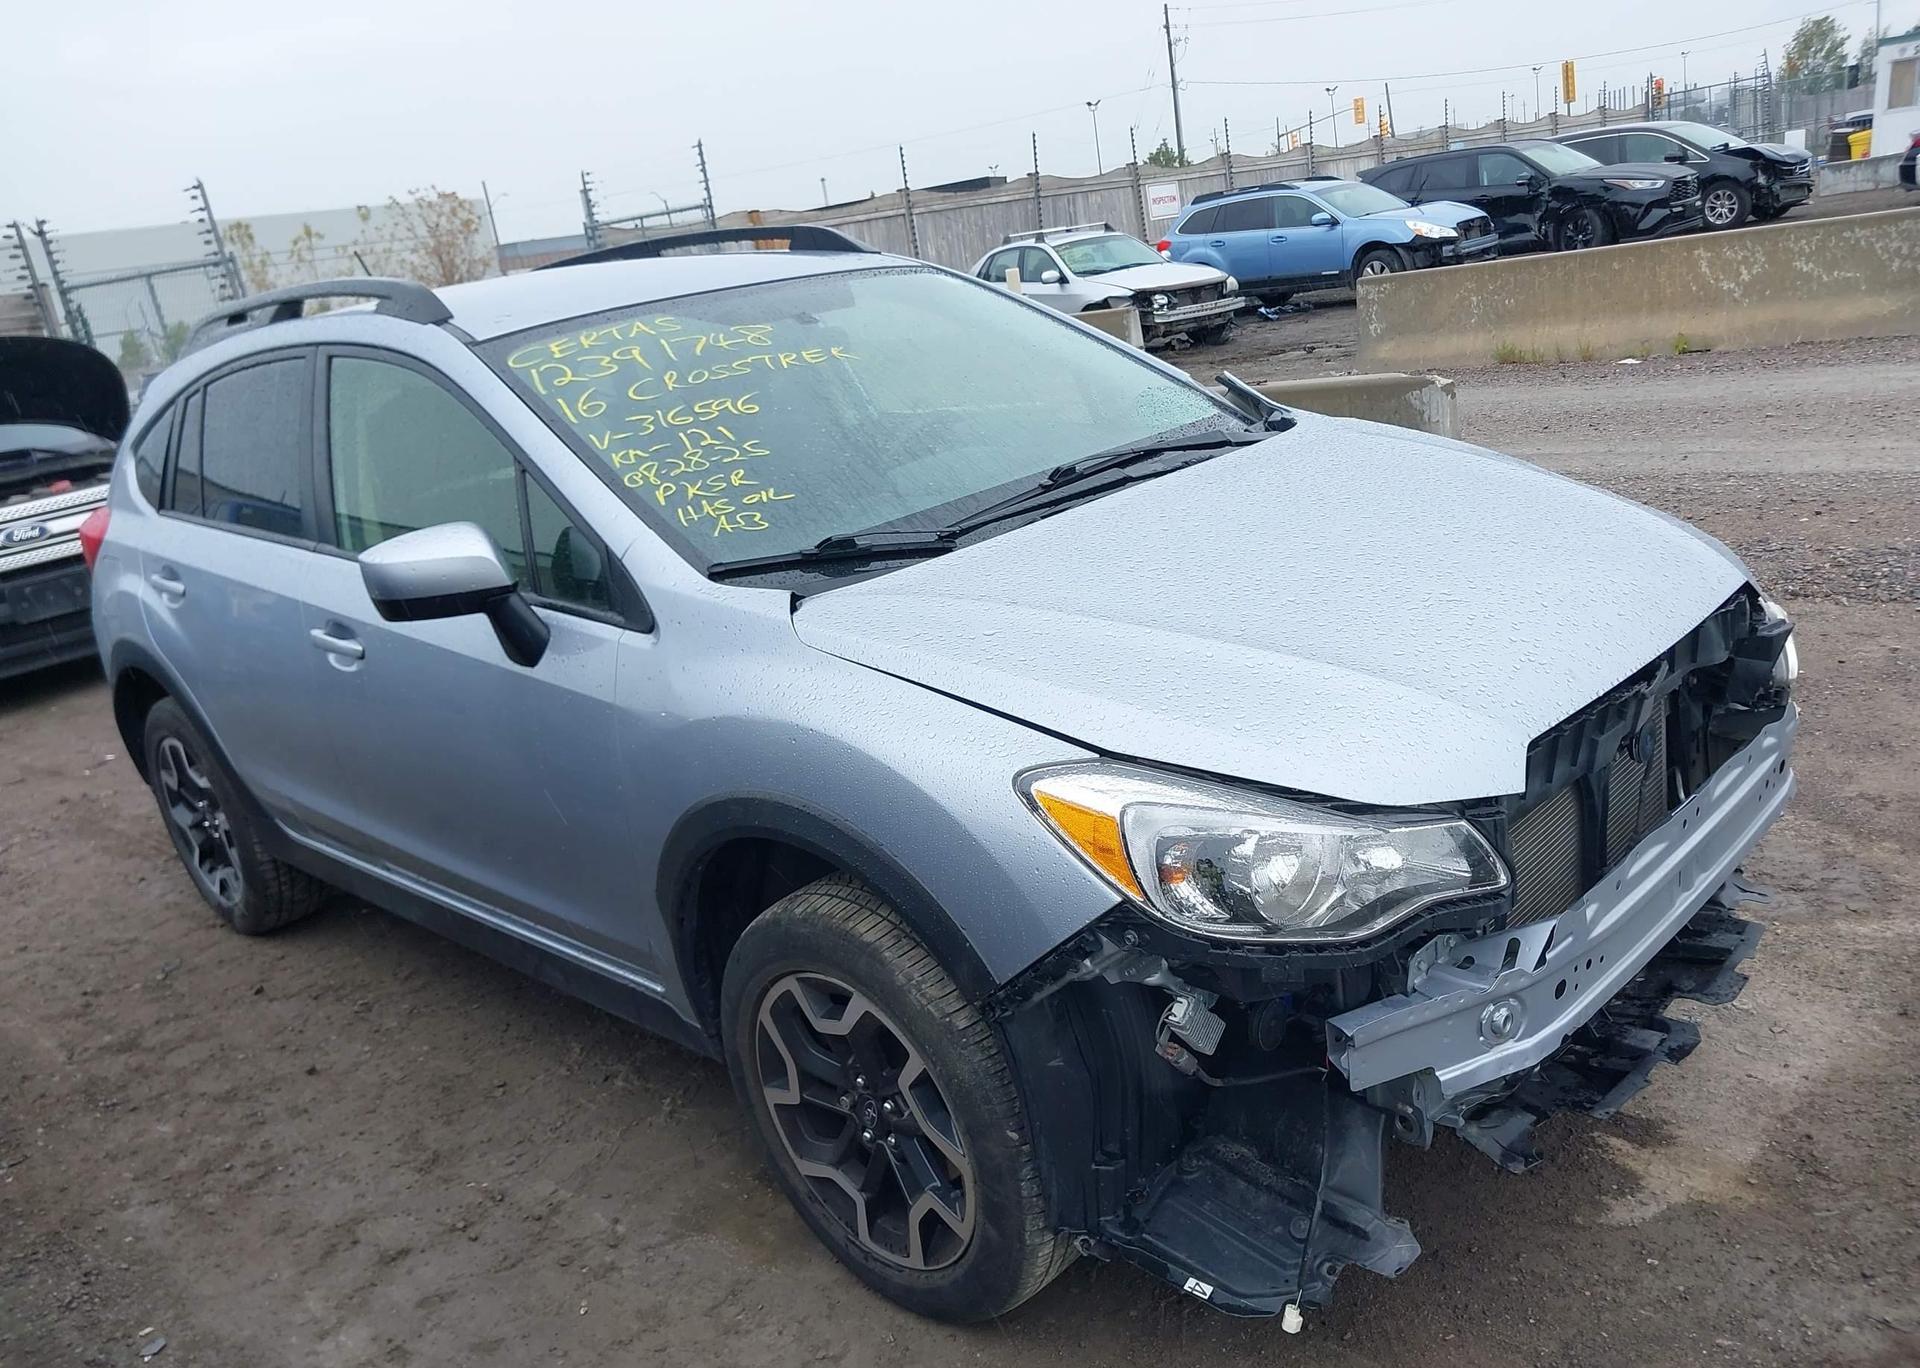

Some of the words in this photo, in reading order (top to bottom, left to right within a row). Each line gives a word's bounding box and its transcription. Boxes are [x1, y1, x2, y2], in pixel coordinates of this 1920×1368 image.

[507, 317, 682, 368] CERTAS
[556, 387, 607, 424] 16
[627, 346, 859, 401] CROSSTREK
[677, 498, 736, 527] HAS
[13, 526, 40, 541] Ford
